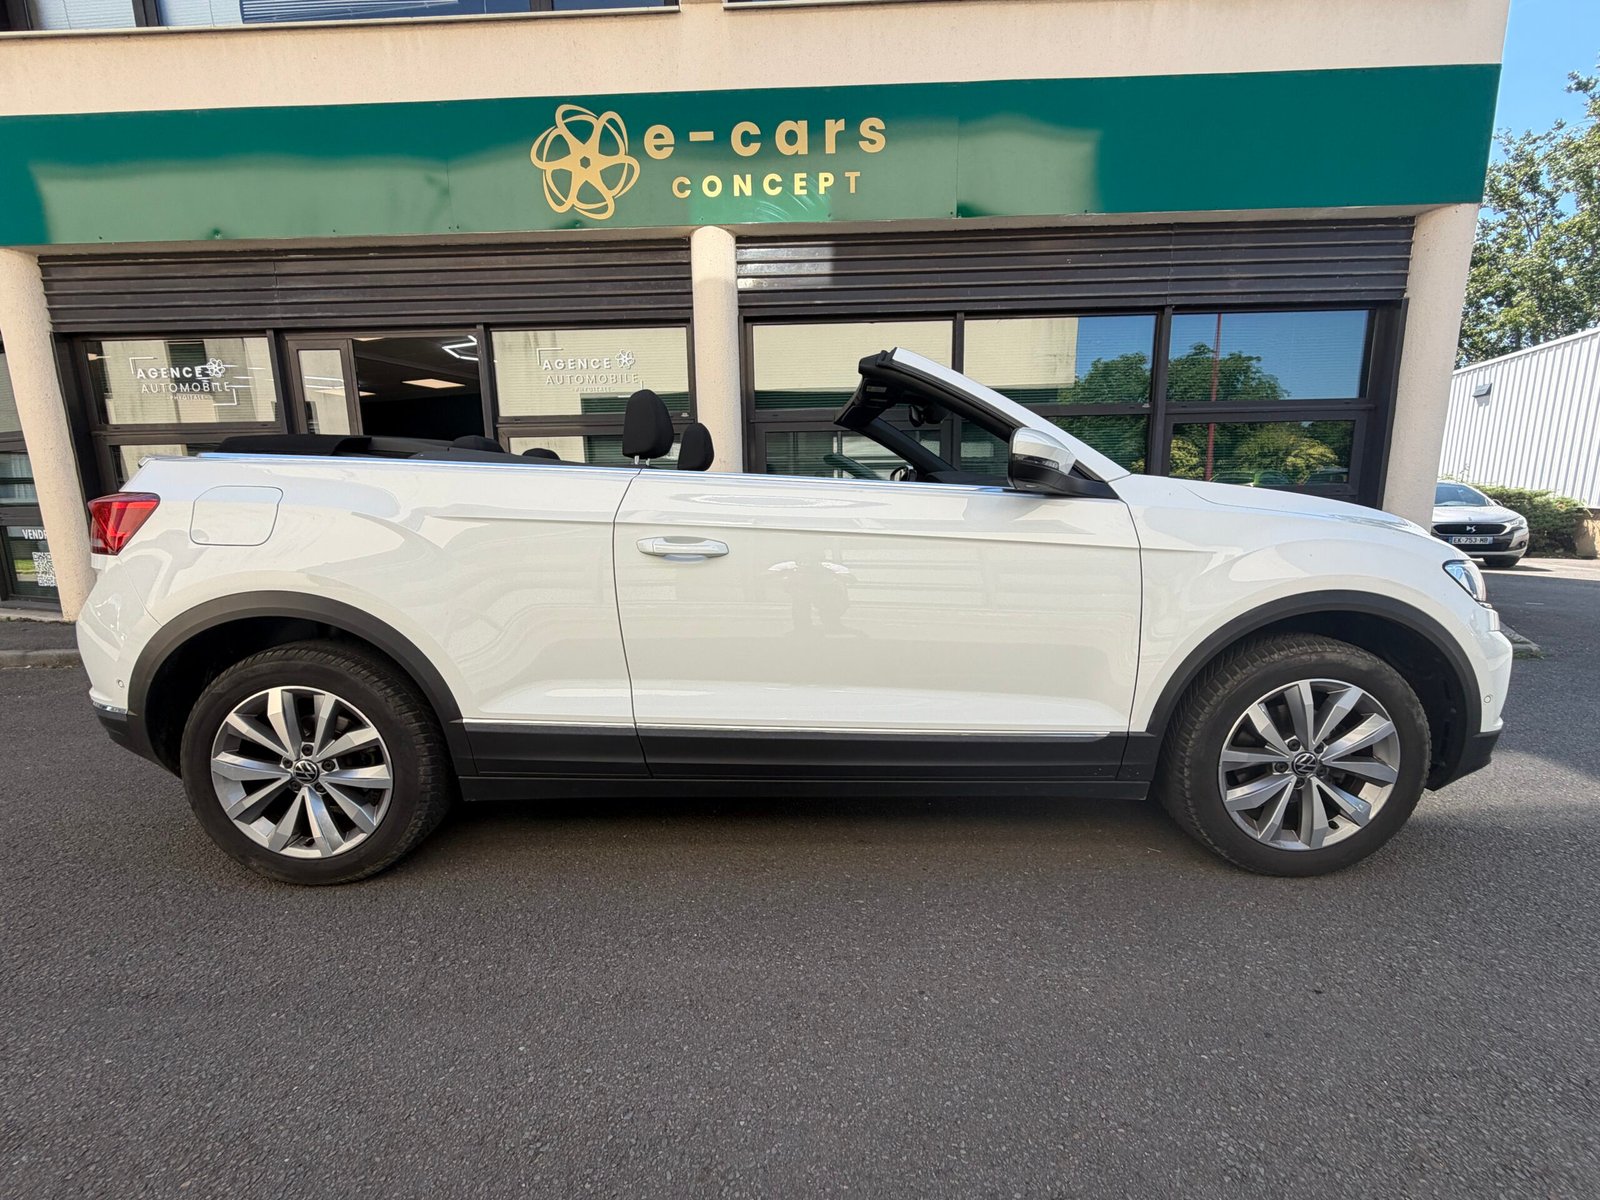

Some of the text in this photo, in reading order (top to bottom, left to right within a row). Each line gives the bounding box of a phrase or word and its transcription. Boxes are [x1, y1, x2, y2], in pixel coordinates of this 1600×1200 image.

[643, 116, 887, 160] e-cars
[672, 171, 862, 199] CONCEPT
[542, 357, 612, 371] AGENCE
[136, 366, 204, 379] AGENCE
[545, 373, 640, 386] AUTOMOBILE
[141, 381, 232, 394] AUTOMOBILE
